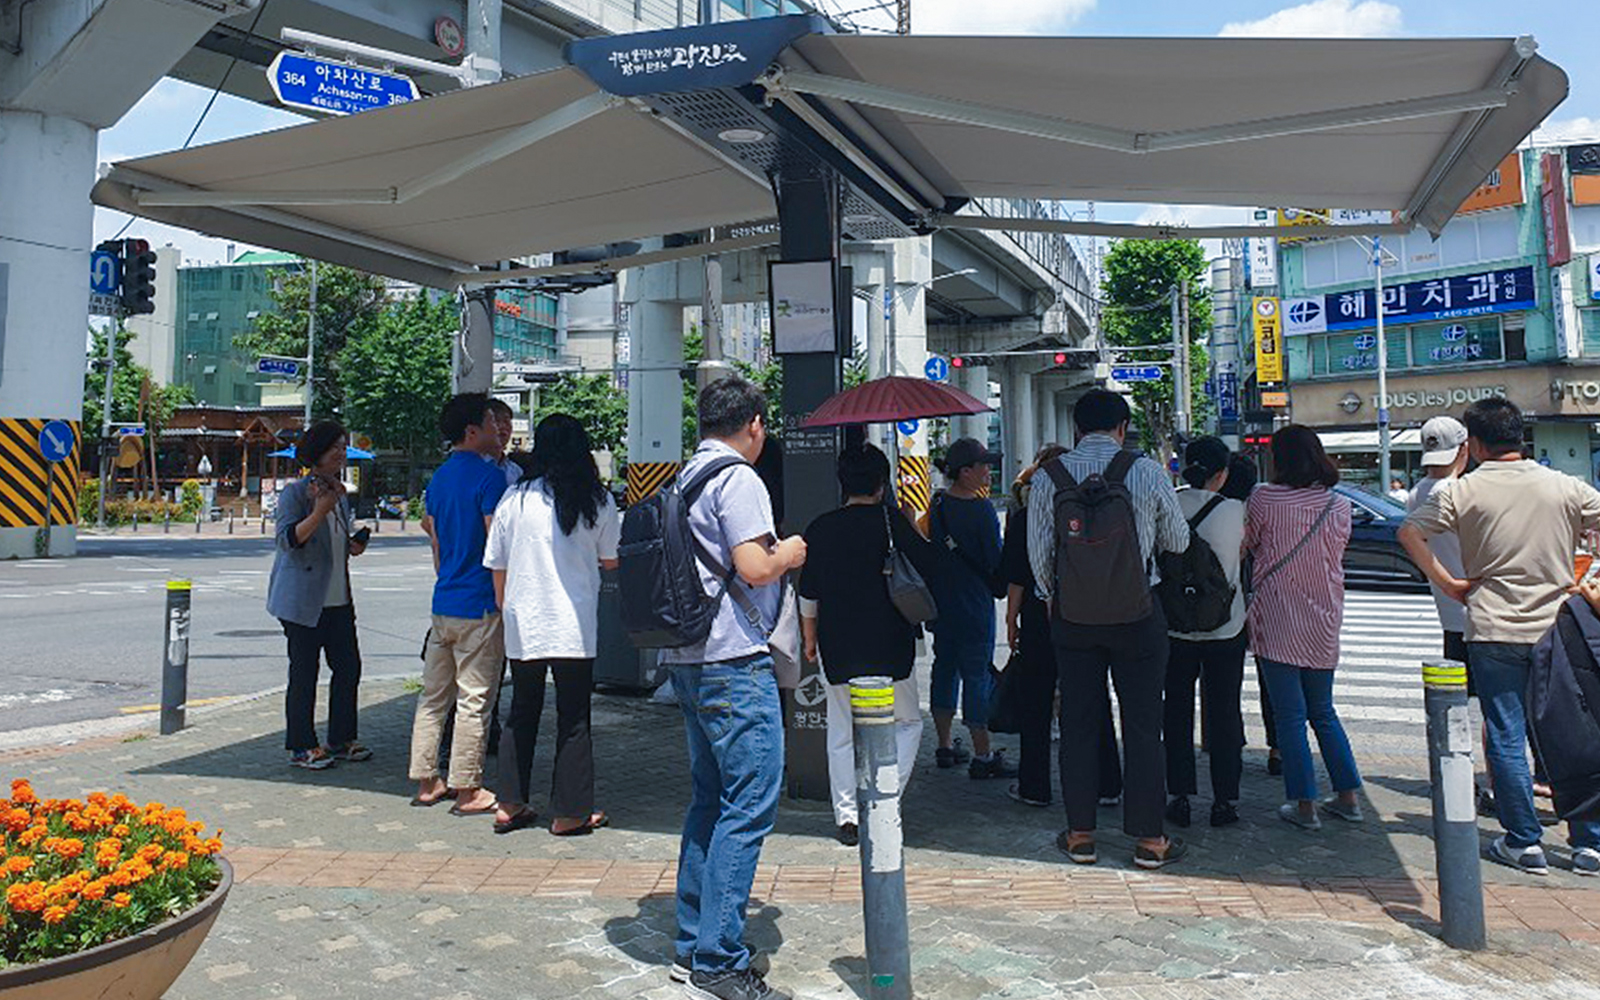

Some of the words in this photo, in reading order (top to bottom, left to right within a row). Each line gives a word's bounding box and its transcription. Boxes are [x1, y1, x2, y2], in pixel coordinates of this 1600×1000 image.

[282, 71, 306, 87] 364
[315, 64, 383, 91] 아차산로
[1339, 273, 1500, 319] 혜민치과
[1503, 272, 1517, 300] 의원
[1372, 391, 1418, 408] TOUS
[1420, 390, 1444, 408] les
[1444, 385, 1506, 409] JOURS
